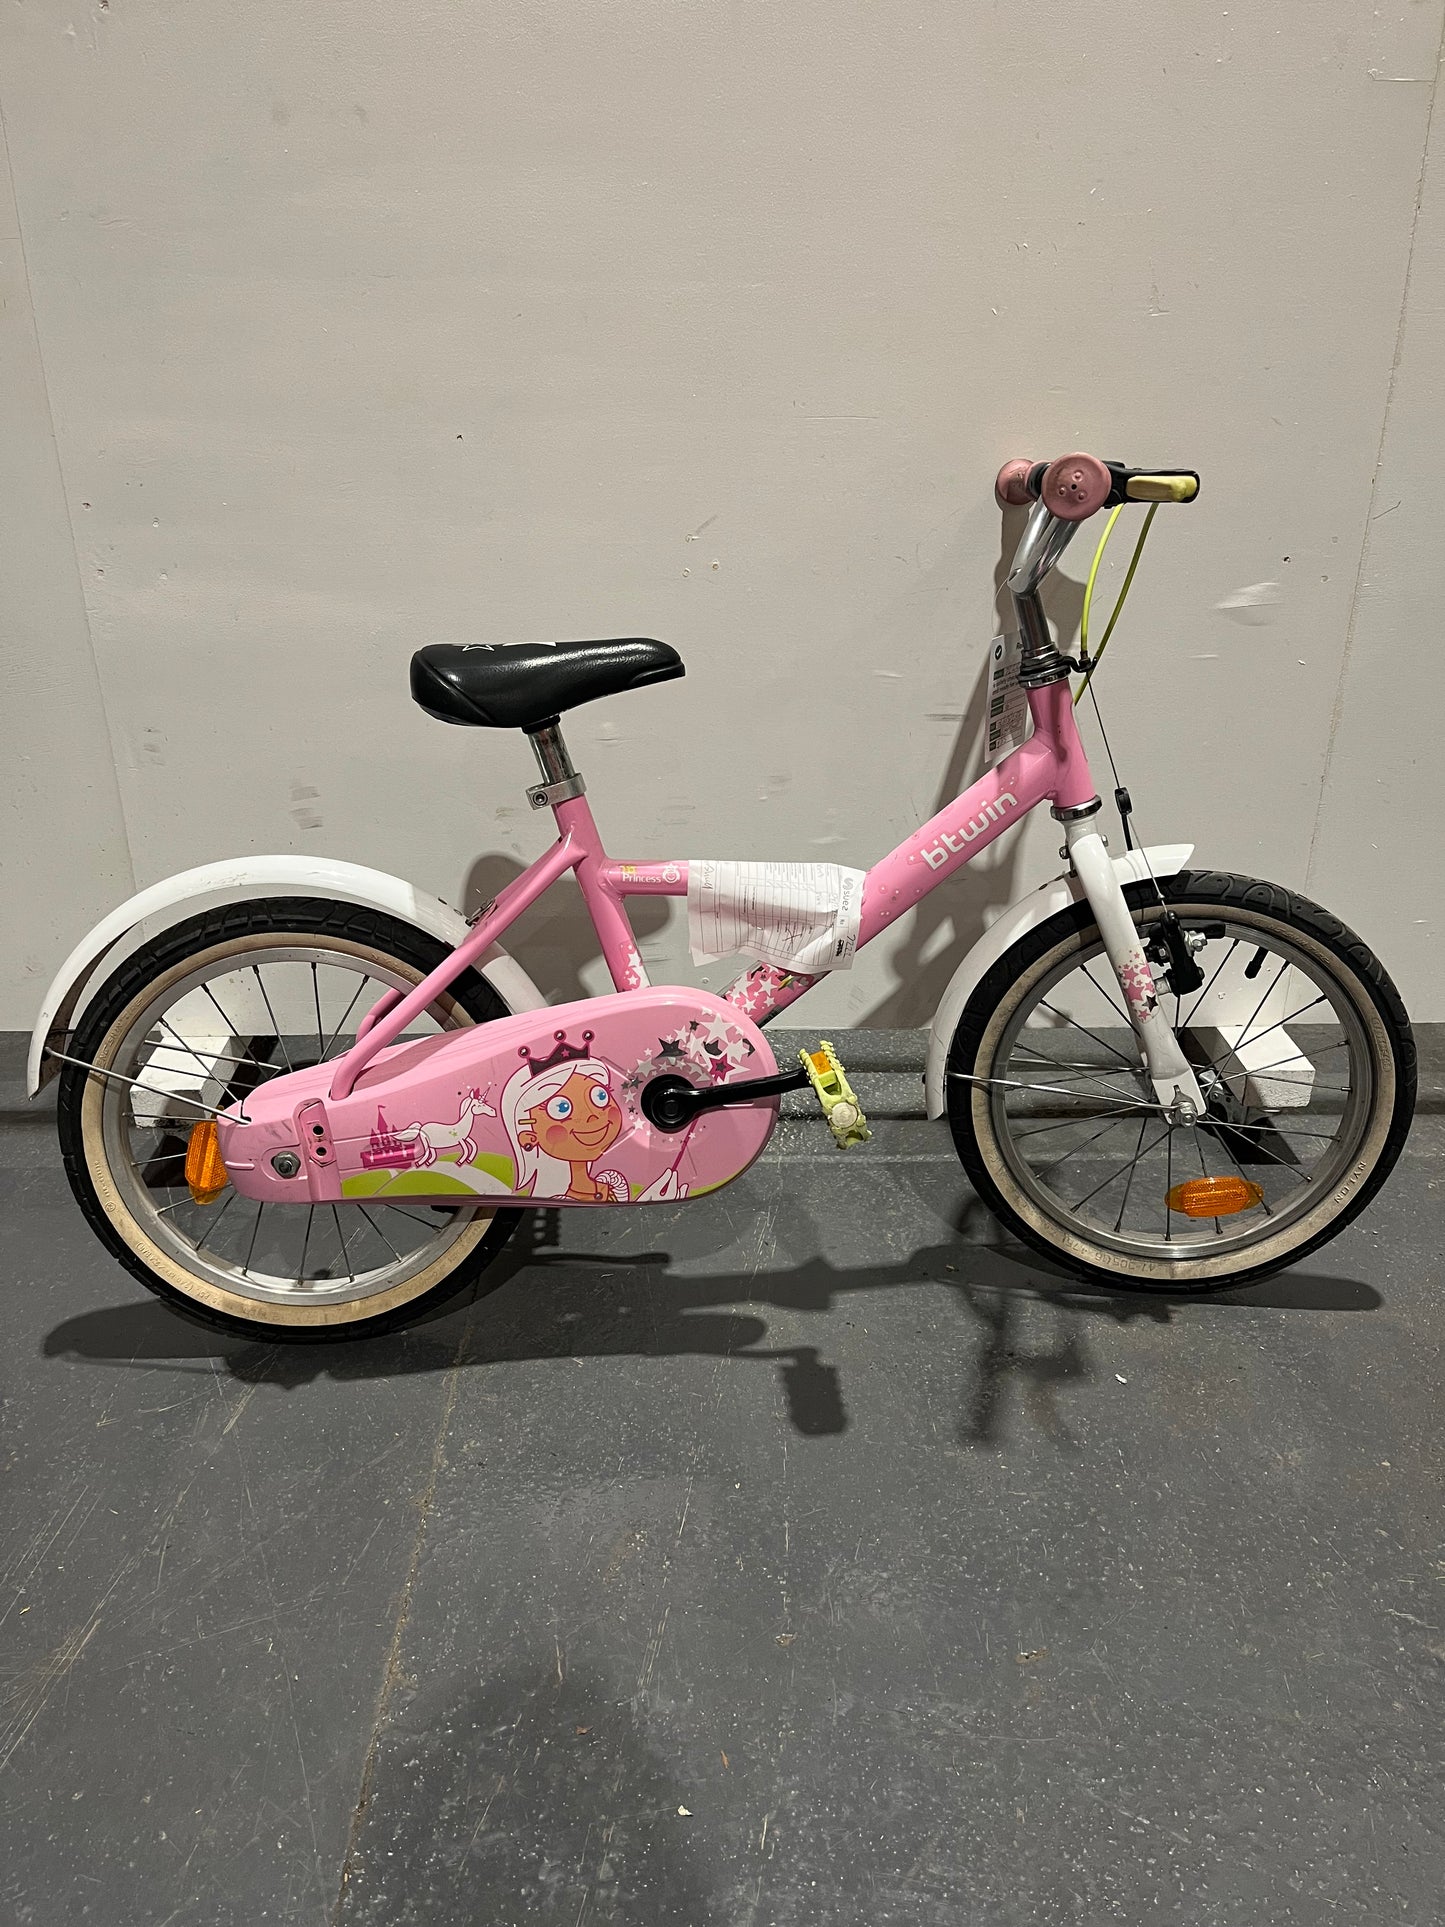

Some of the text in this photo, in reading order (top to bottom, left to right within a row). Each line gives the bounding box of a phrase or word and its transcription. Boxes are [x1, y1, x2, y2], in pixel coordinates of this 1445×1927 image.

[622, 873, 662, 883] Princess
[841, 890, 850, 912] suez
[1333, 1161, 1367, 1204] NYLON
